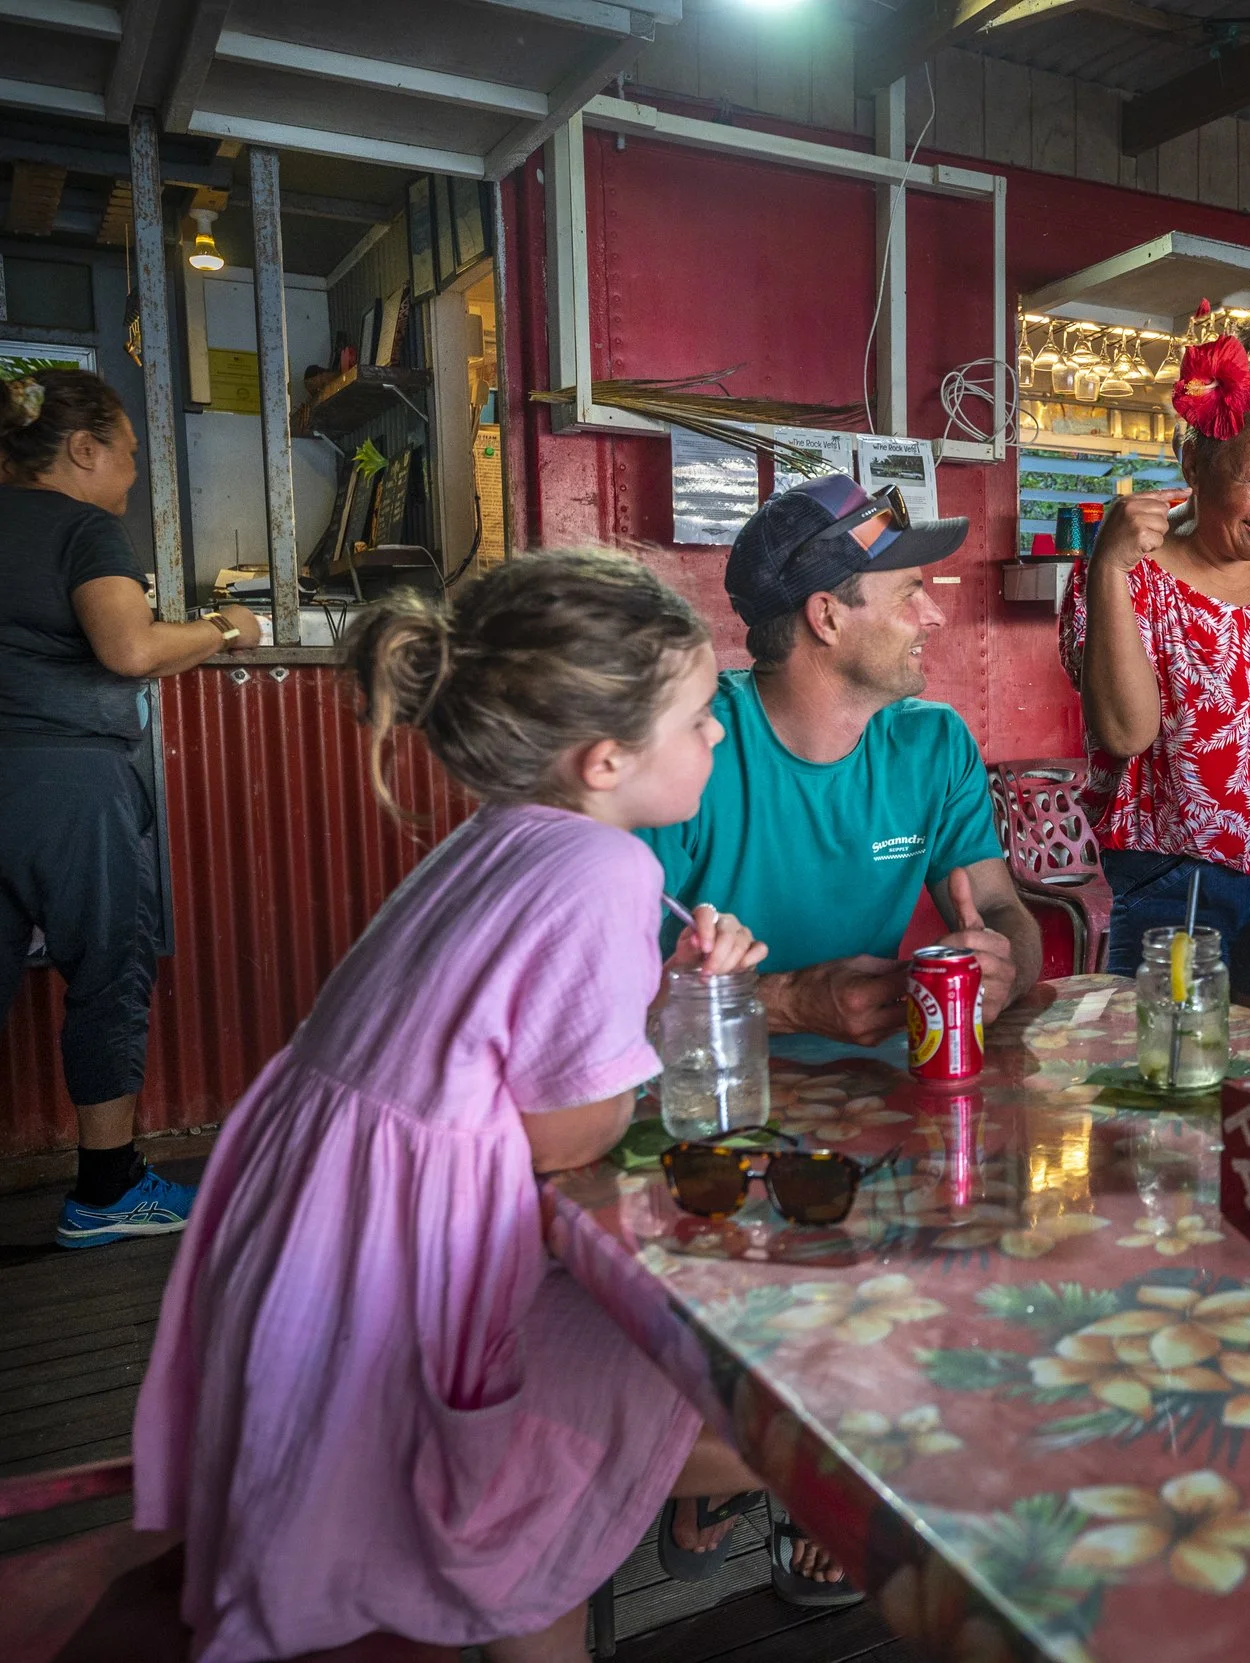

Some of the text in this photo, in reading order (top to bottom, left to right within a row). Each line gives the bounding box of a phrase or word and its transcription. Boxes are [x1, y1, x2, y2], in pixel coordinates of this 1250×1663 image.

[806, 439, 822, 449] Rock
[888, 443, 904, 452] Rock
[913, 983, 938, 1017] RED
